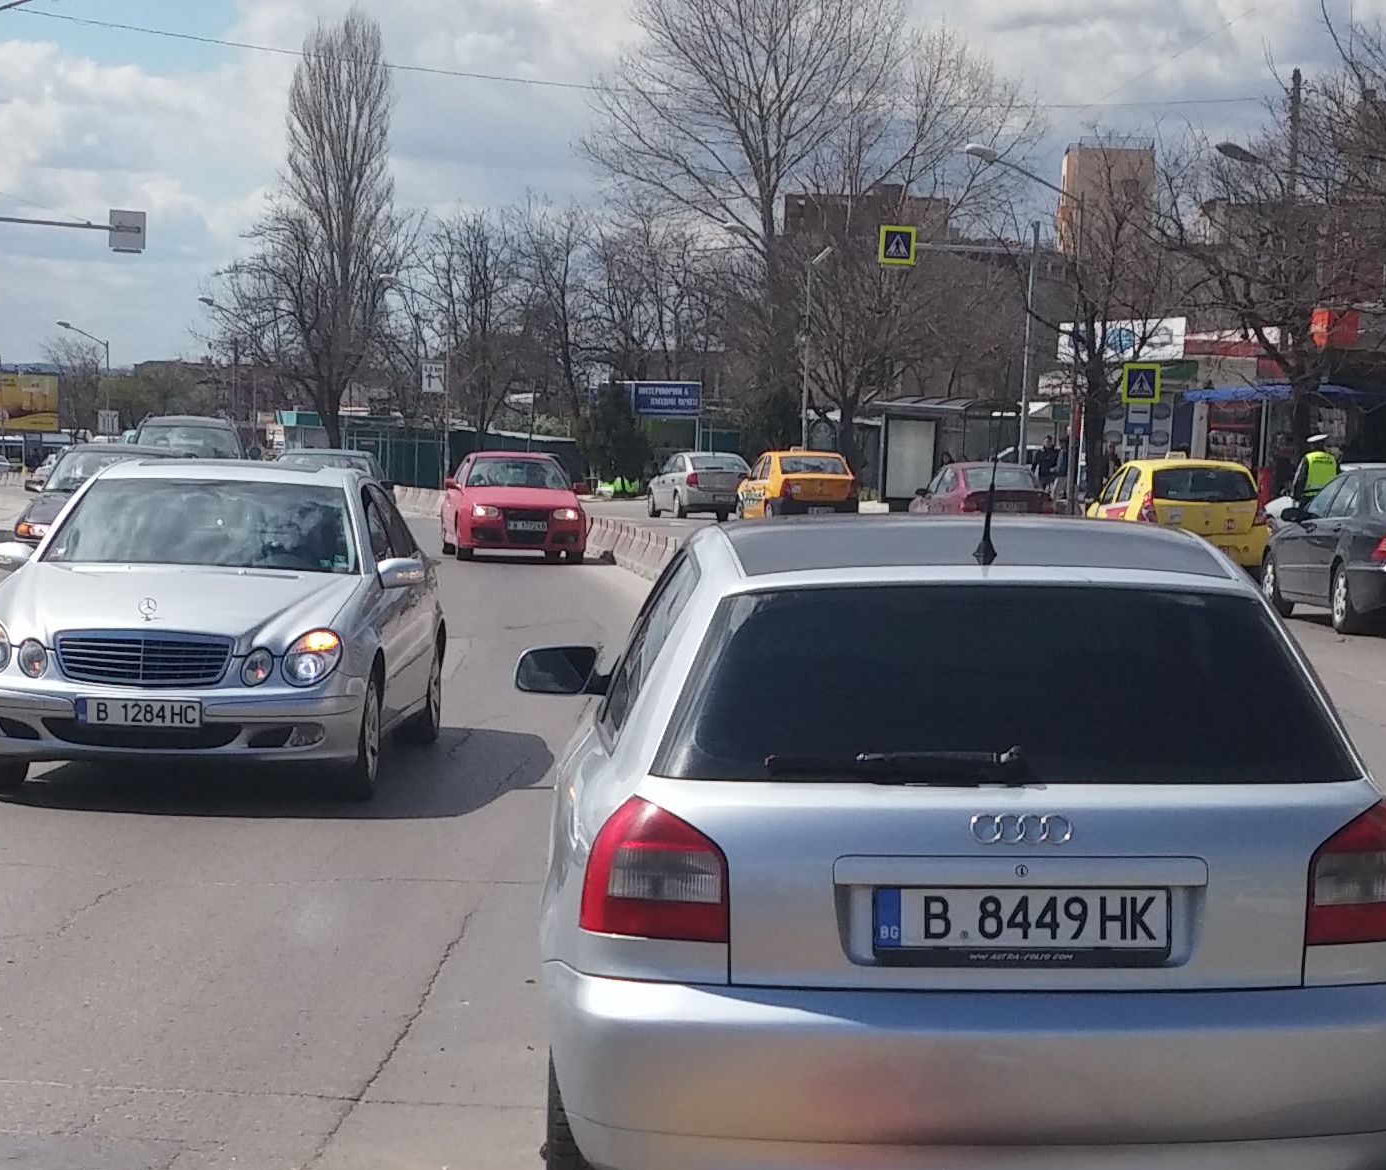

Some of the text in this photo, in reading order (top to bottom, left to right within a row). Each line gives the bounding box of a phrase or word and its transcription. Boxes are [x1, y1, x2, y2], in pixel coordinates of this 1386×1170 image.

[96, 702, 196, 724] B 1284 HC
[924, 896, 1157, 940] B 8449 HK
[879, 927, 900, 940] BG
